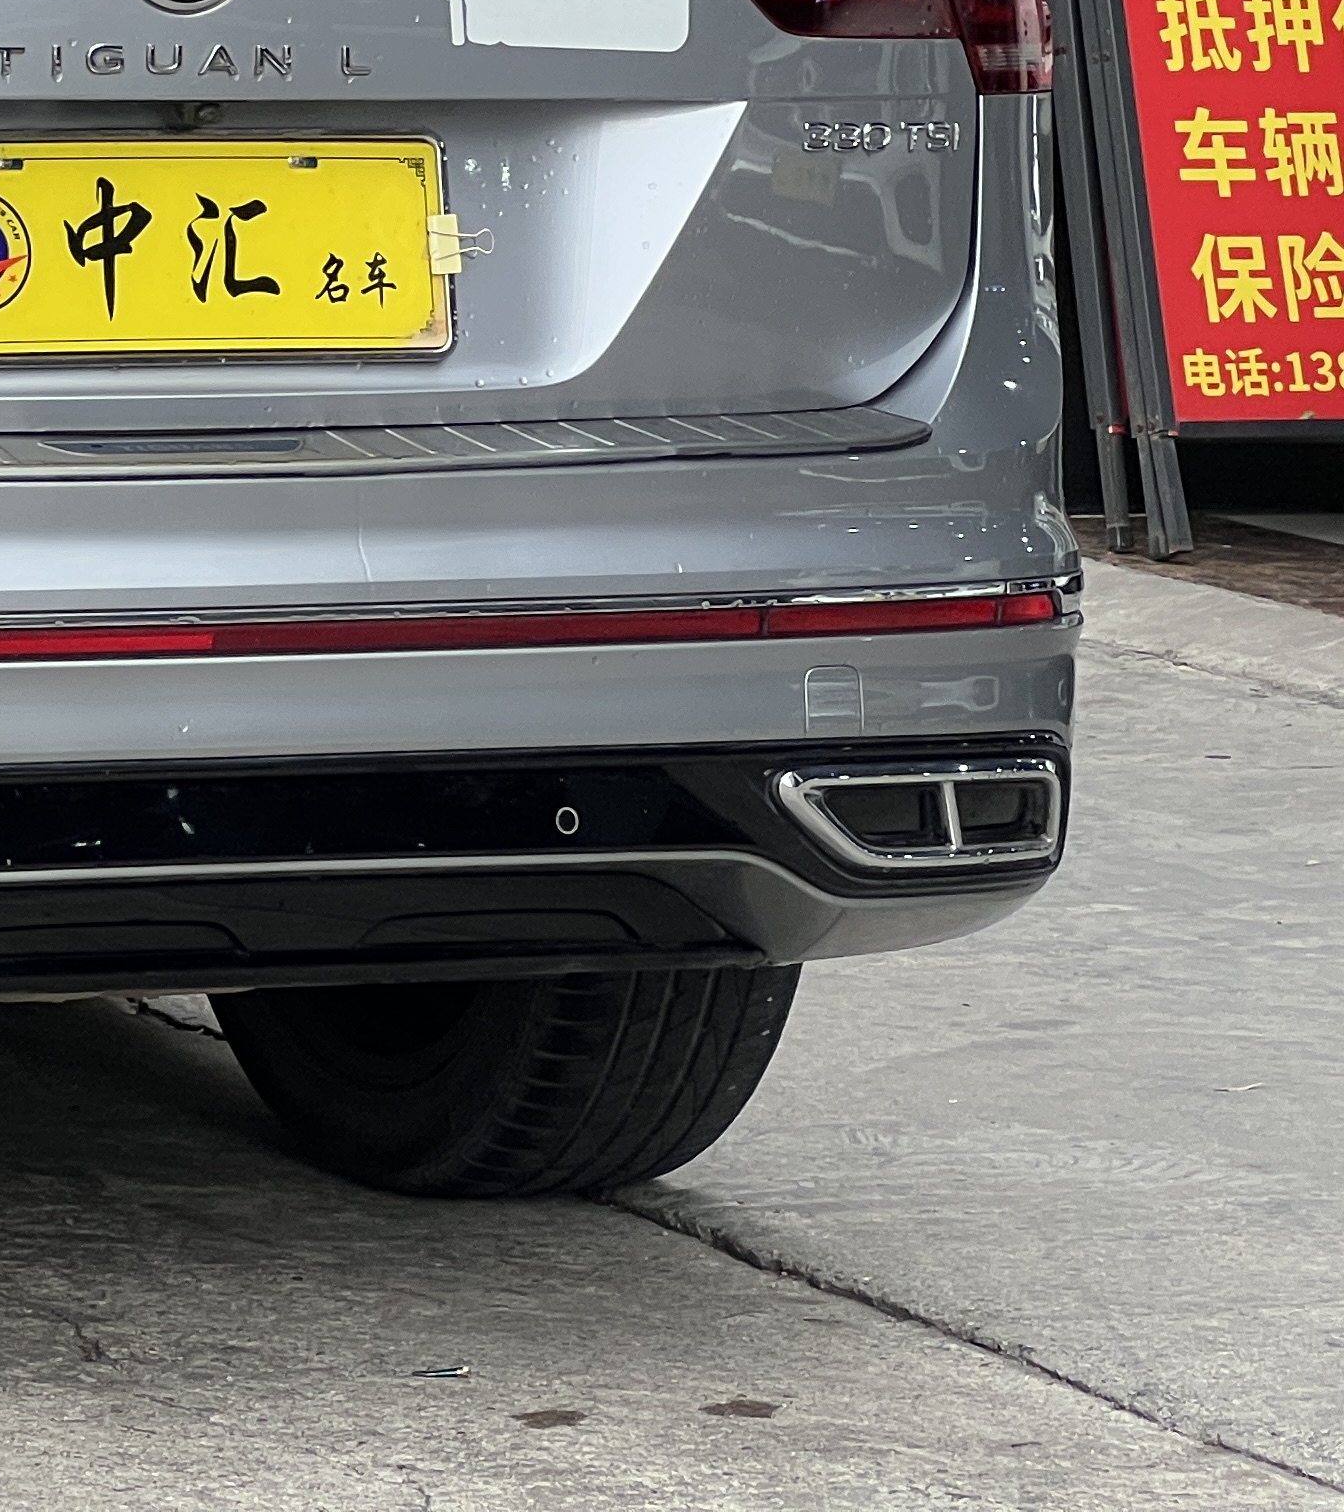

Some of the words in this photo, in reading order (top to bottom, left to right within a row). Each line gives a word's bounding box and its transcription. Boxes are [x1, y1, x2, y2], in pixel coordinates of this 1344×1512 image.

[339, 44, 373, 77] L
[802, 121, 892, 152] 330
[900, 121, 960, 152] TSI
[1173, 107, 1344, 199] 车辆
[1191, 231, 1344, 324] 保险
[1182, 347, 1344, 398] 电话:13
